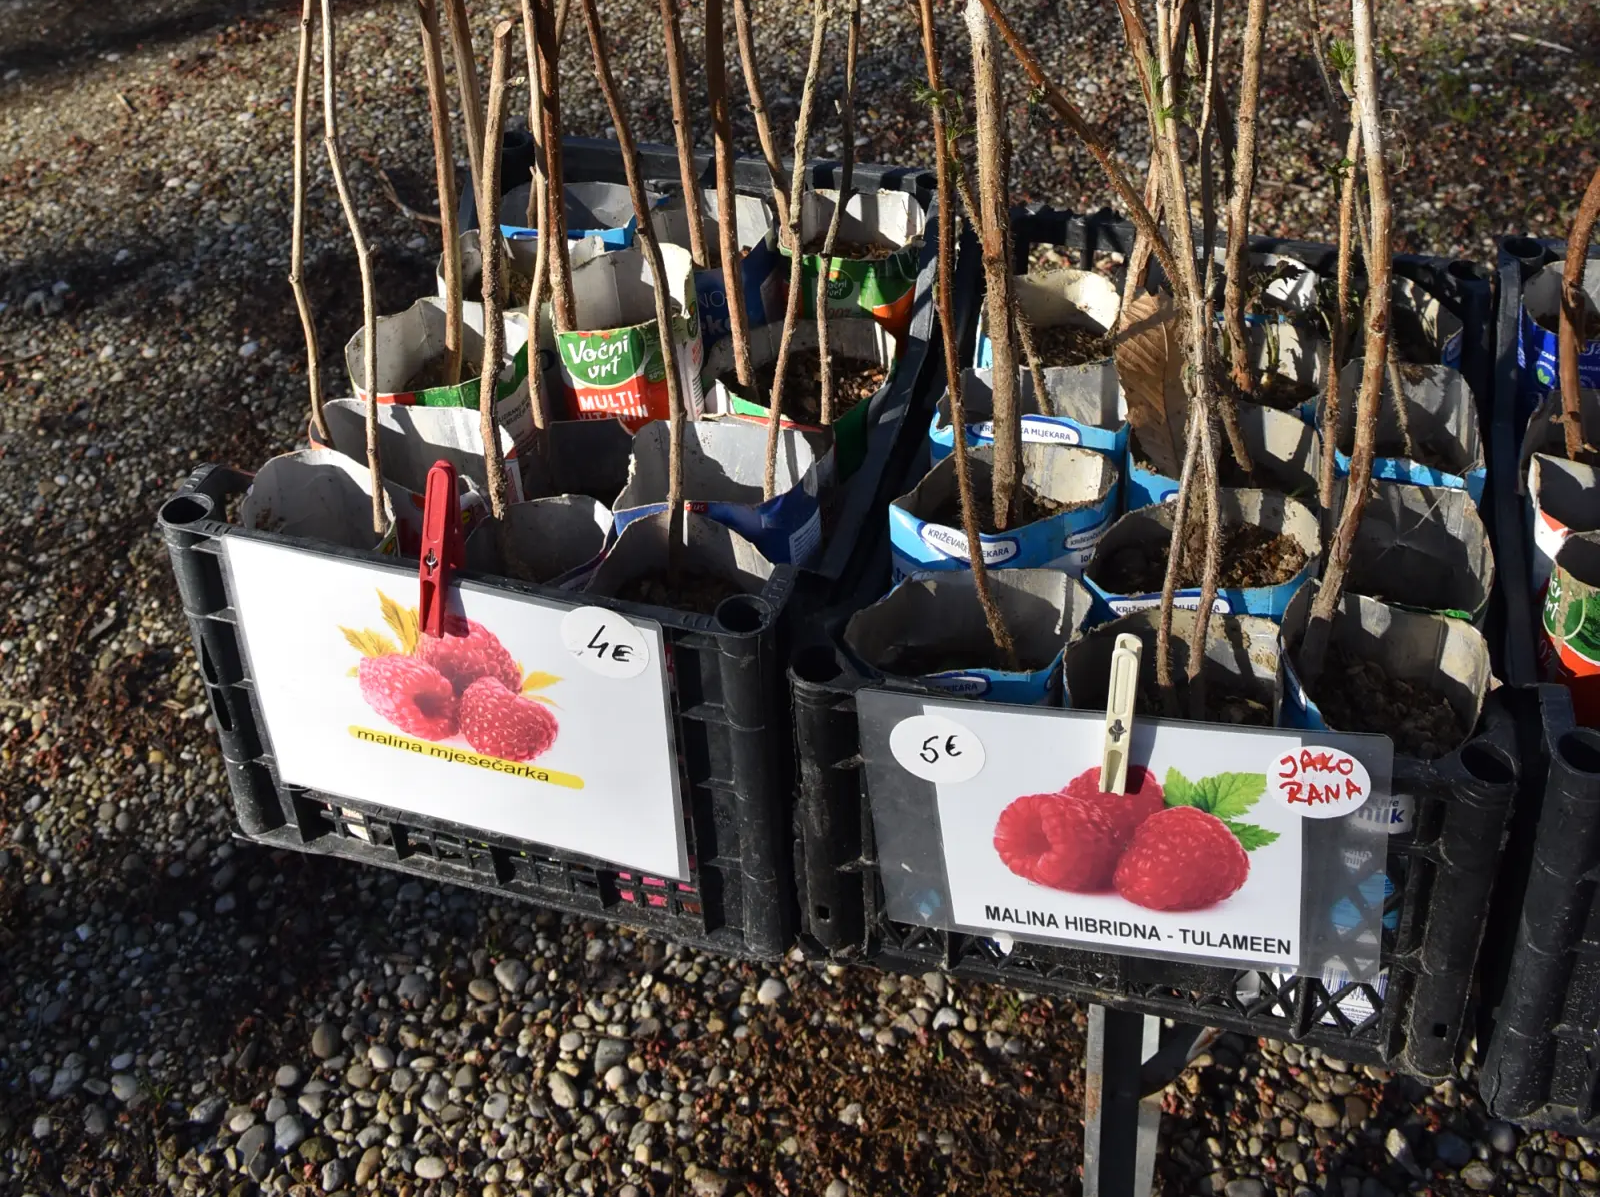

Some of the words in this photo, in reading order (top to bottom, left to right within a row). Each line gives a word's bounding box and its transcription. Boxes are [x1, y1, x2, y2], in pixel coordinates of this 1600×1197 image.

[567, 335, 629, 365] Voćni
[587, 357, 622, 380] vrt
[579, 390, 641, 412] MULTI-
[357, 727, 423, 754] malina
[430, 744, 550, 783] mjesečarka
[919, 735, 963, 764] 5€
[1278, 749, 1355, 779] JAKO
[1278, 777, 1363, 807] RANA
[984, 904, 1060, 929] MALINA
[1064, 914, 1162, 941] HIBRIDNA
[1178, 927, 1292, 955] TULAMEEN
